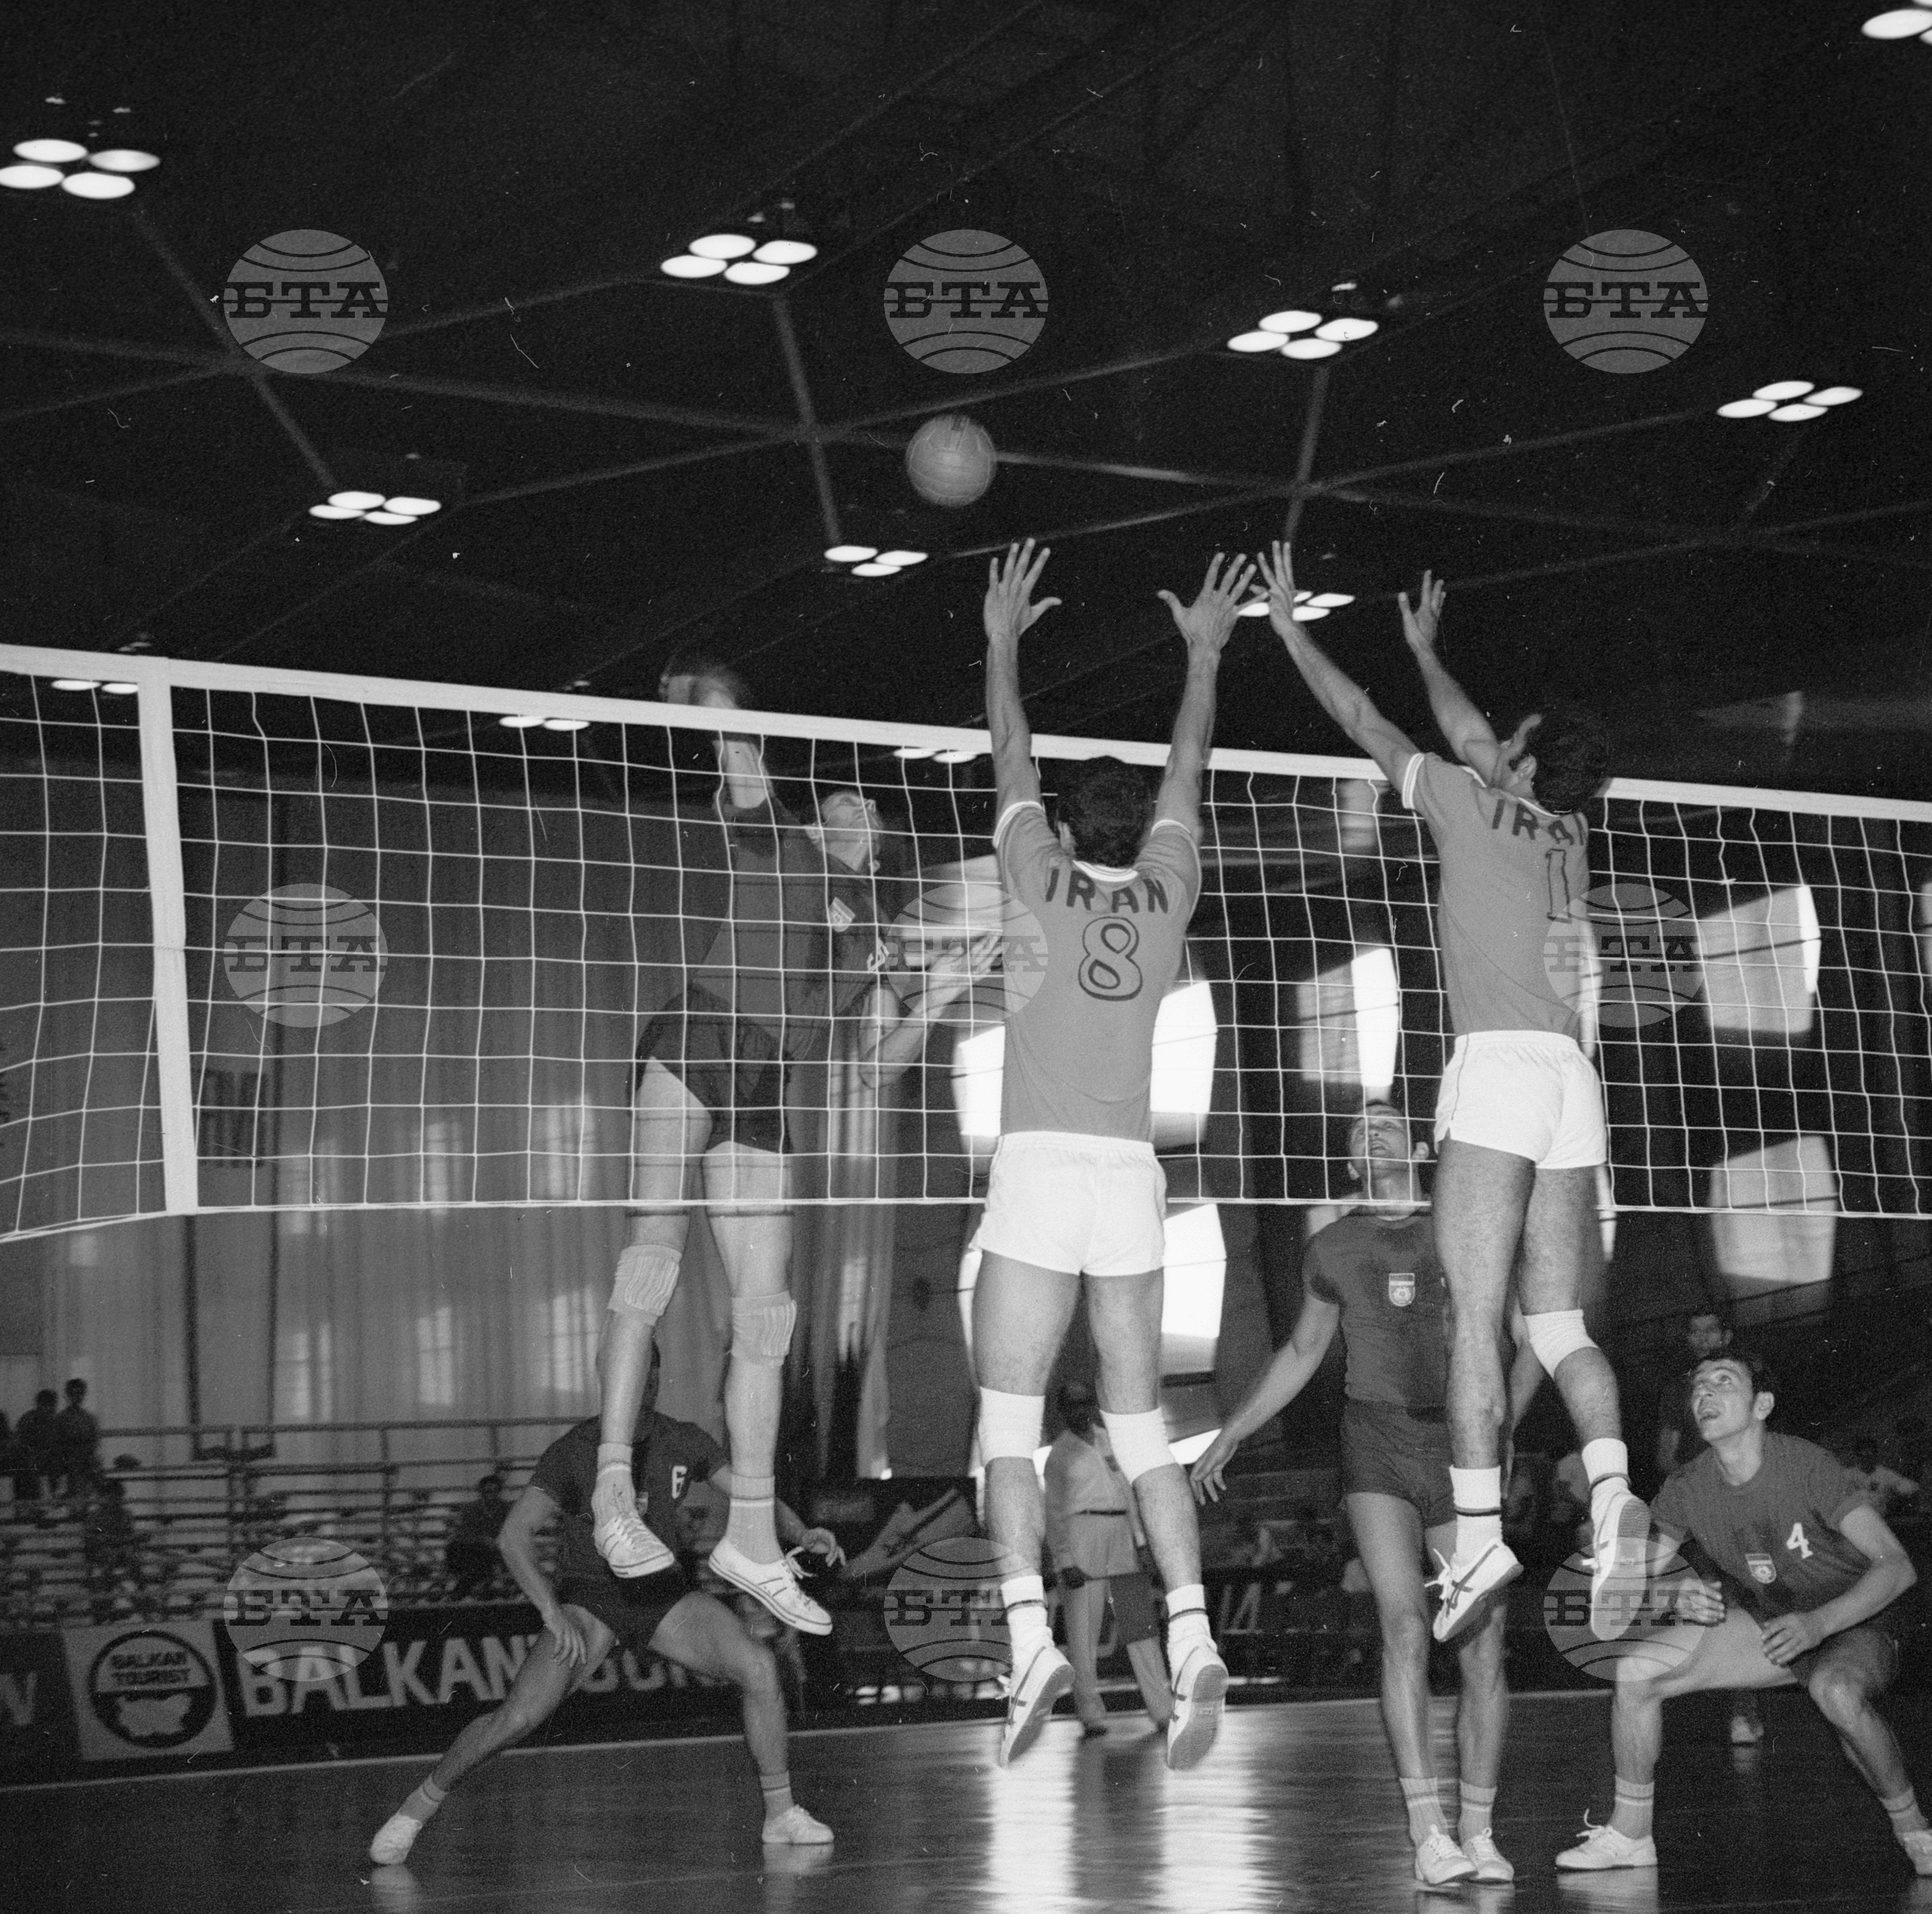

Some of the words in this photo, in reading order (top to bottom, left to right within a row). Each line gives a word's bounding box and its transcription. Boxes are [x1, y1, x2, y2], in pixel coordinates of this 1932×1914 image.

[1045, 868, 1168, 914] IRAN
[1078, 916, 1143, 1002] 8
[1787, 1522, 1814, 1559] 4
